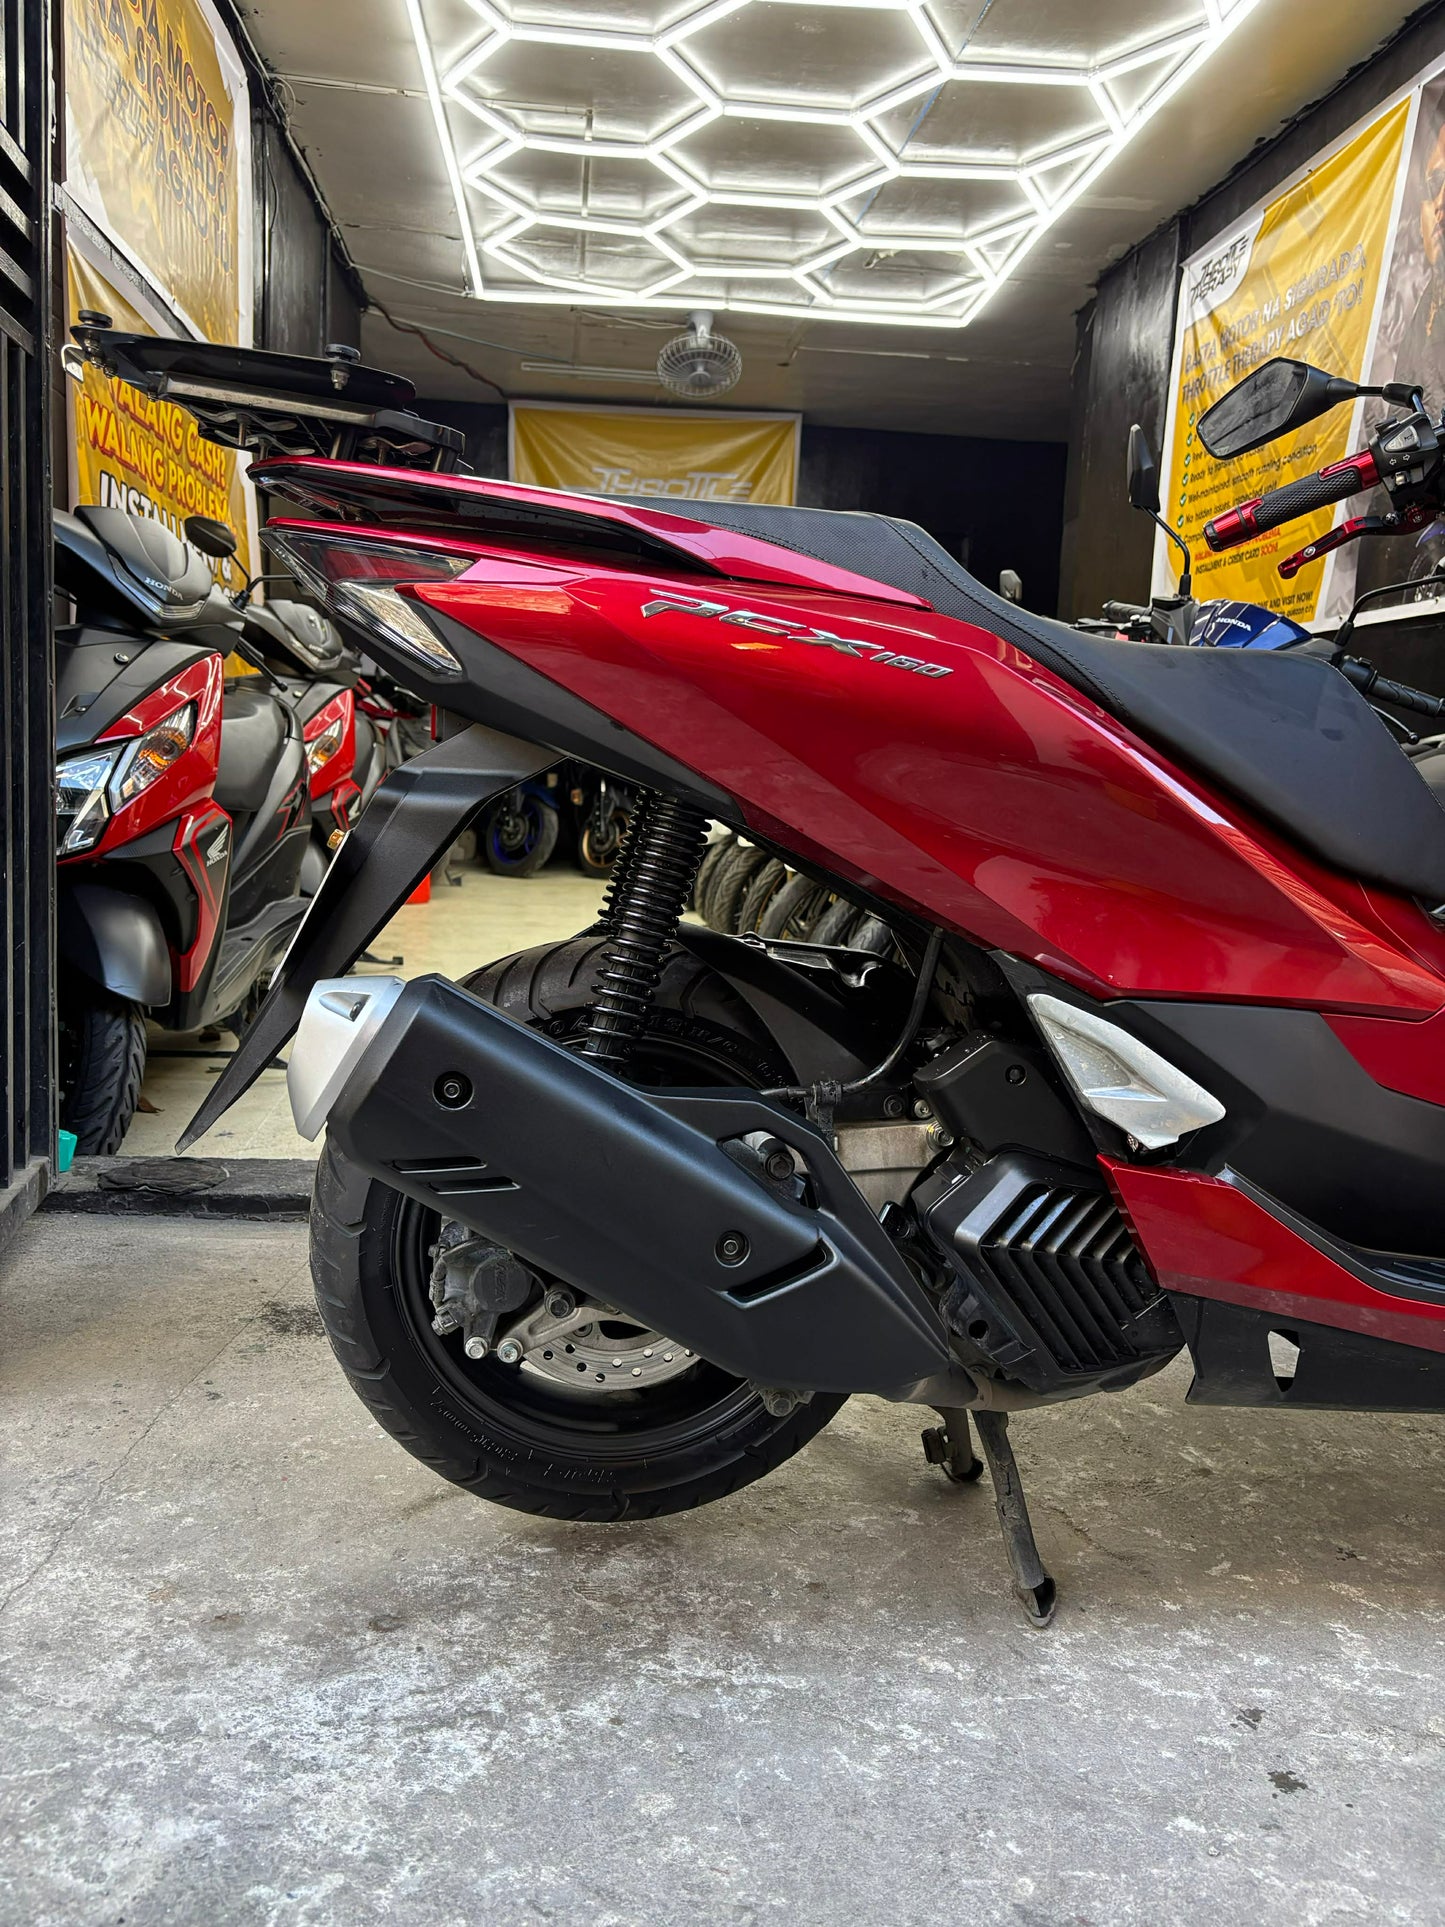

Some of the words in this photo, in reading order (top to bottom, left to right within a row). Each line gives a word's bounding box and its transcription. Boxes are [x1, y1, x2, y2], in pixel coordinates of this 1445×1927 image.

[166, 24, 229, 163] MOTOR
[134, 26, 228, 216] SIGURADO
[155, 129, 208, 240] AGAD
[1262, 296, 1281, 326] NA
[1182, 358, 1231, 404] THROTTLE
[1232, 325, 1285, 377] THERAPY
[1286, 299, 1332, 345] AGAD
[84, 393, 167, 493] WALANG
[590, 466, 753, 501] THROTTLE
[1194, 556, 1222, 575] INSTALLMENT
[1227, 551, 1244, 566] CREDIT
[1245, 547, 1260, 561] CARD
[143, 575, 184, 601] HONDA
[1270, 598, 1281, 609] AND
[1281, 594, 1296, 607] VISIT
[1215, 616, 1252, 632] HONDA
[869, 650, 954, 678] 160
